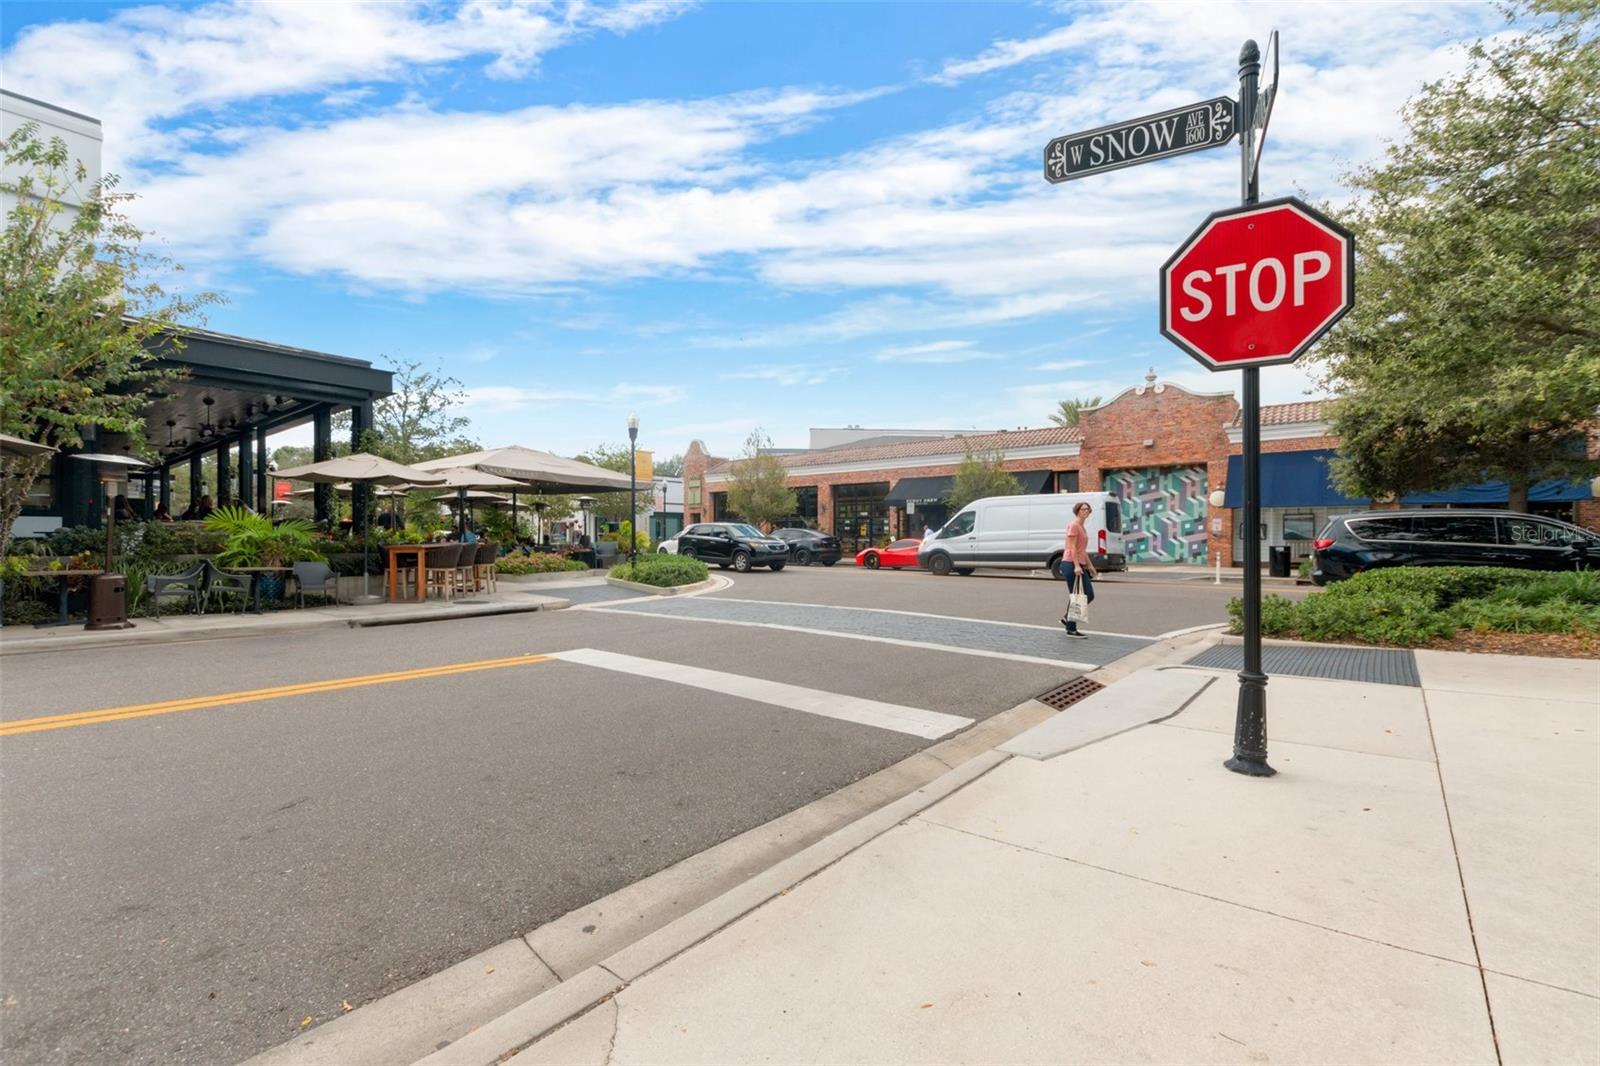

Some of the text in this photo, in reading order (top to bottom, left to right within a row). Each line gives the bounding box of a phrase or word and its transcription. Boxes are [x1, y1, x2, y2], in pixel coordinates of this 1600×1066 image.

[1185, 127, 1205, 145] 1600
[1186, 110, 1205, 129] AVE
[1071, 117, 1180, 167] W SNOW
[1179, 250, 1332, 323] STOP
